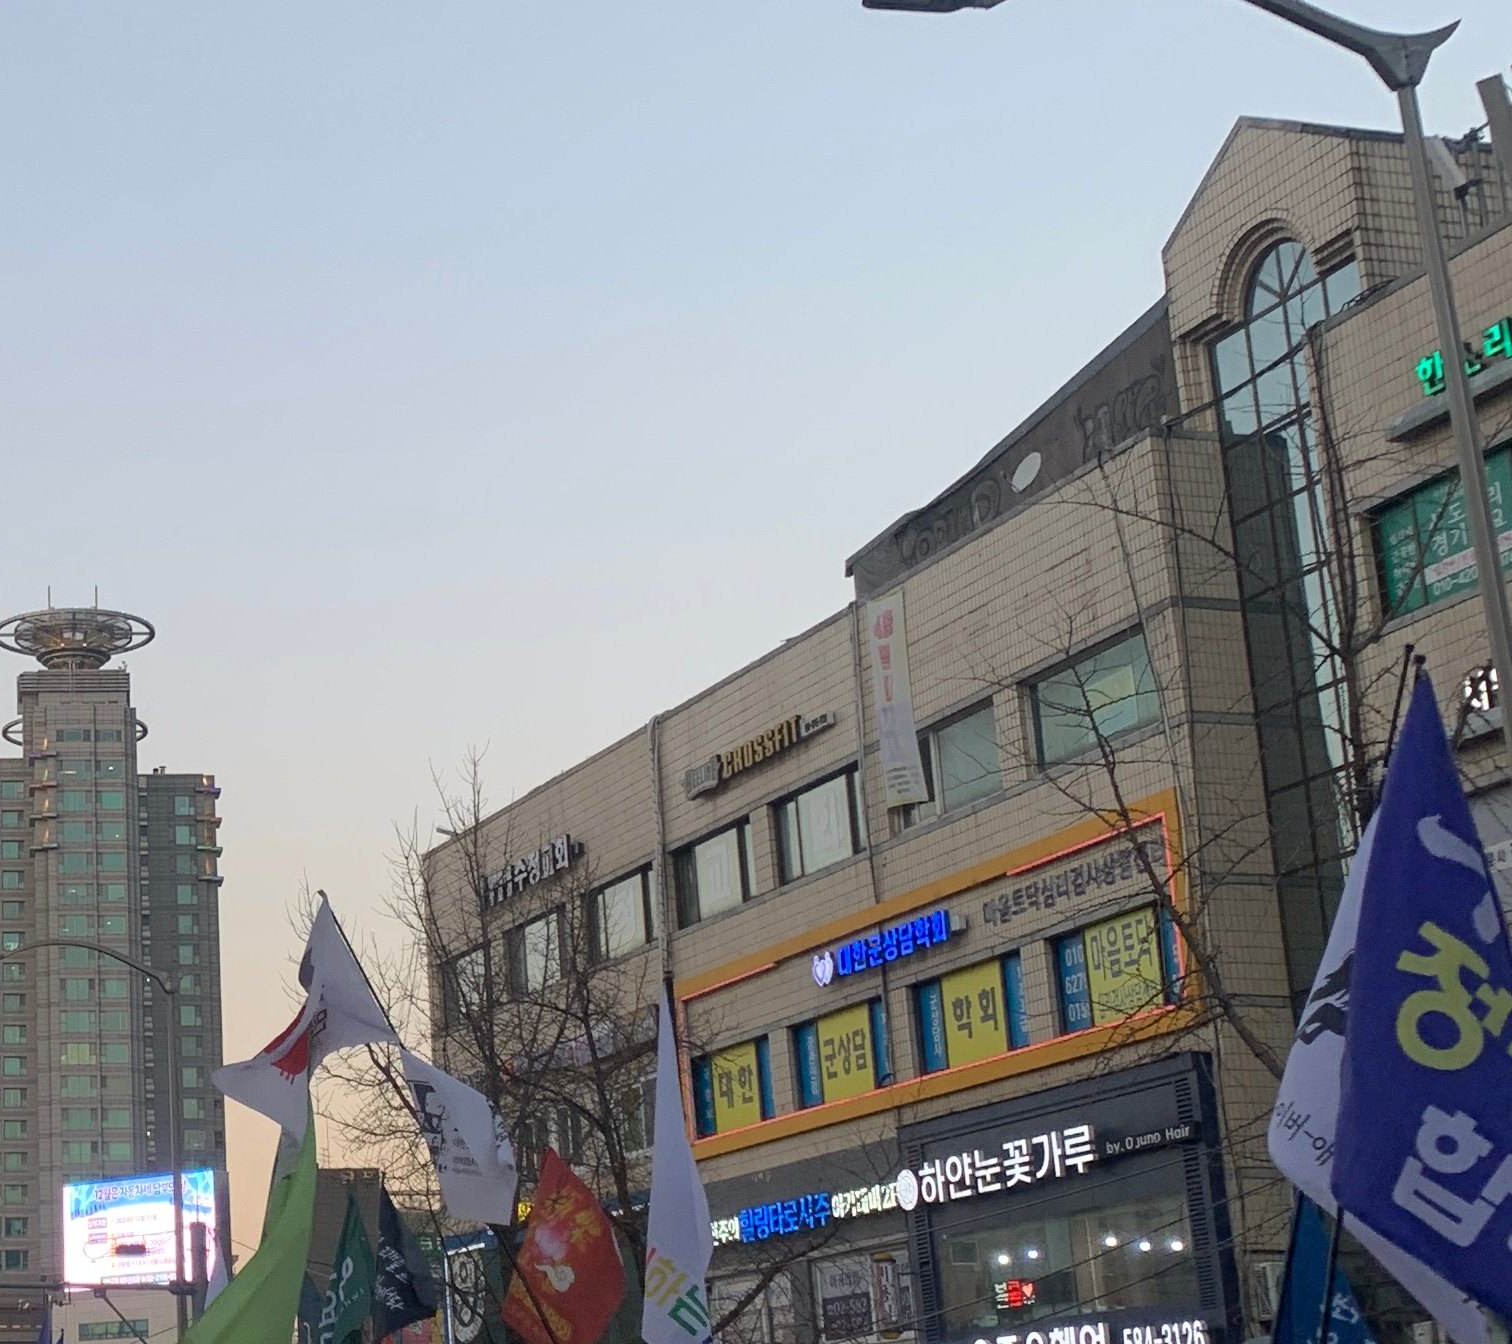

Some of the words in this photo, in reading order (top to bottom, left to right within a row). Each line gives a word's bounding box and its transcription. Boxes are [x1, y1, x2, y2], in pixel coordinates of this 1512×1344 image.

[723, 716, 797, 779] CROSSFIT
[1065, 974, 1088, 995] 627
[951, 986, 999, 1039] 학회
[823, 1028, 867, 1081] 군상담
[718, 1063, 754, 1108] 대한
[918, 1124, 1094, 1203] 하얀눈꽃가루
[740, 1192, 831, 1243] 힐링타로사주
